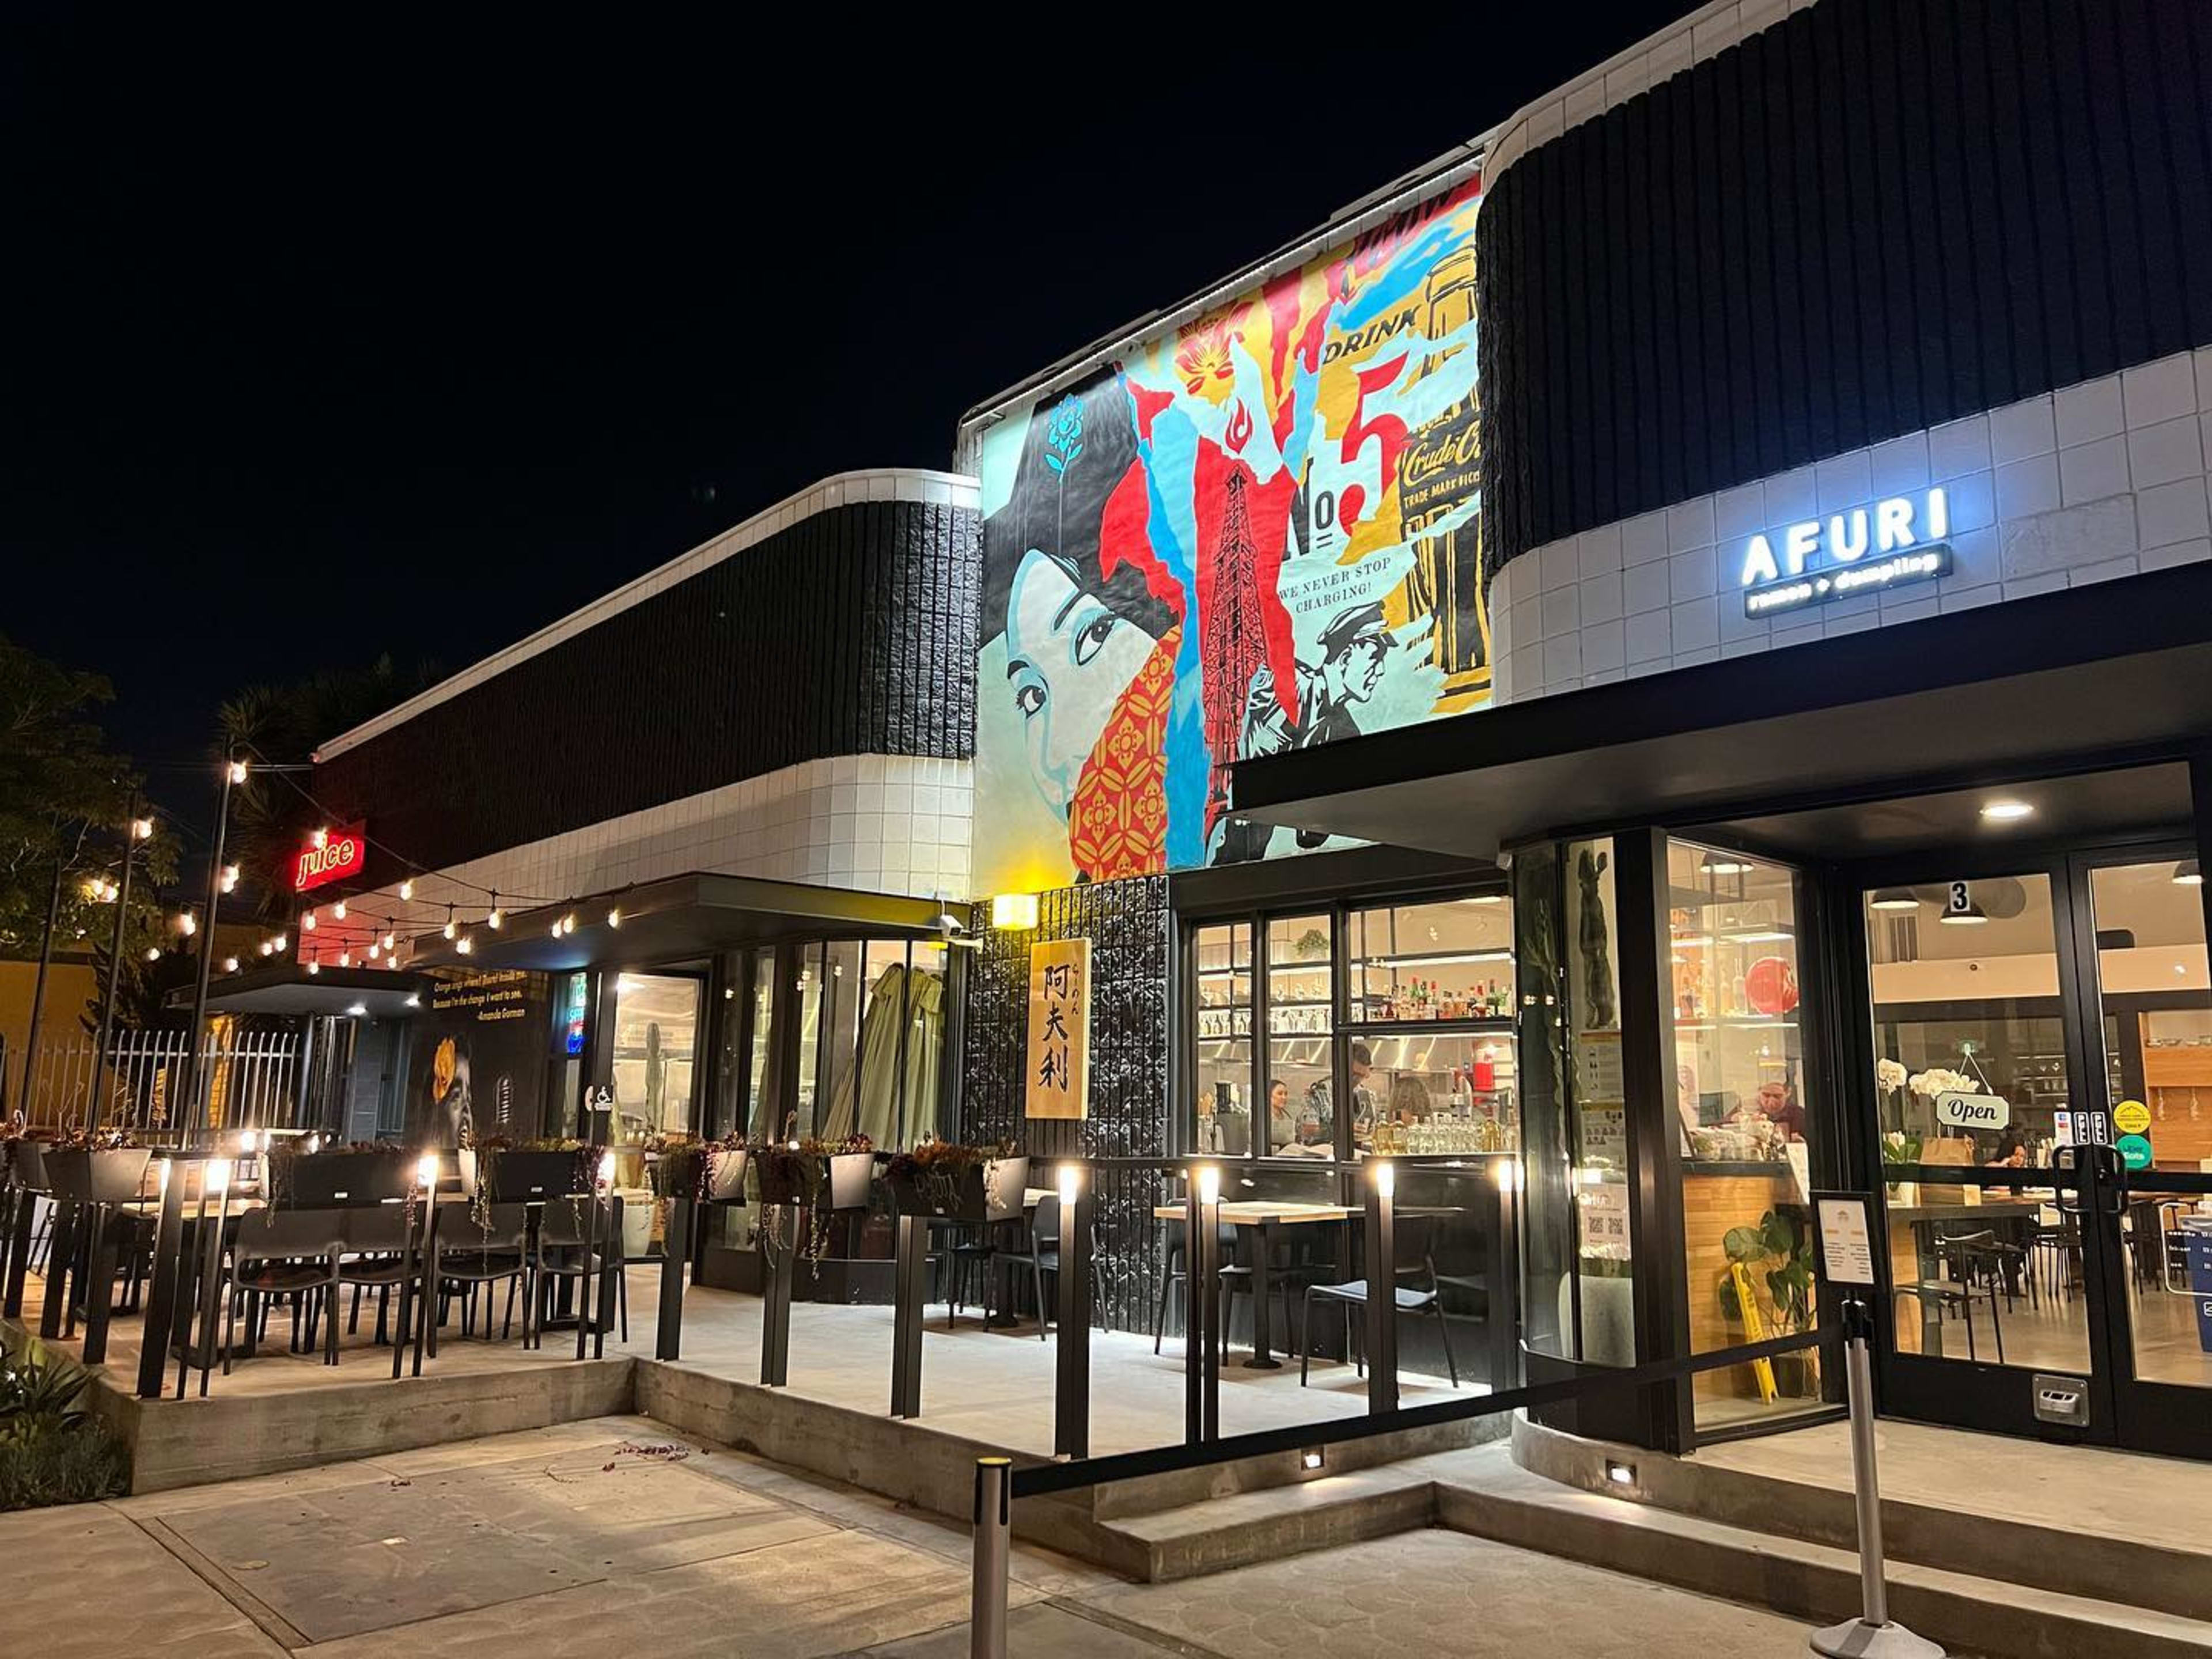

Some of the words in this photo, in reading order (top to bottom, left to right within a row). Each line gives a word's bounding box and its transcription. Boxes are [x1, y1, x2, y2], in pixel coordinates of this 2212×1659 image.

[1324, 305, 1421, 366] DRINK
[1404, 434, 1457, 486] Crude
[1404, 488, 1428, 509] TRADE
[1431, 479, 1457, 497] MARK
[1741, 488, 1947, 586] AFURI
[1279, 586, 1298, 600] WE
[1303, 570, 1350, 594] NEVER
[1355, 556, 1391, 578] STOP
[1835, 553, 1938, 589] dumpling
[1296, 582, 1371, 613] CHARGING!
[1952, 883, 1968, 910] 3
[1039, 964, 1070, 1093] 阿夫利
[1948, 1099, 1998, 1123] Open
